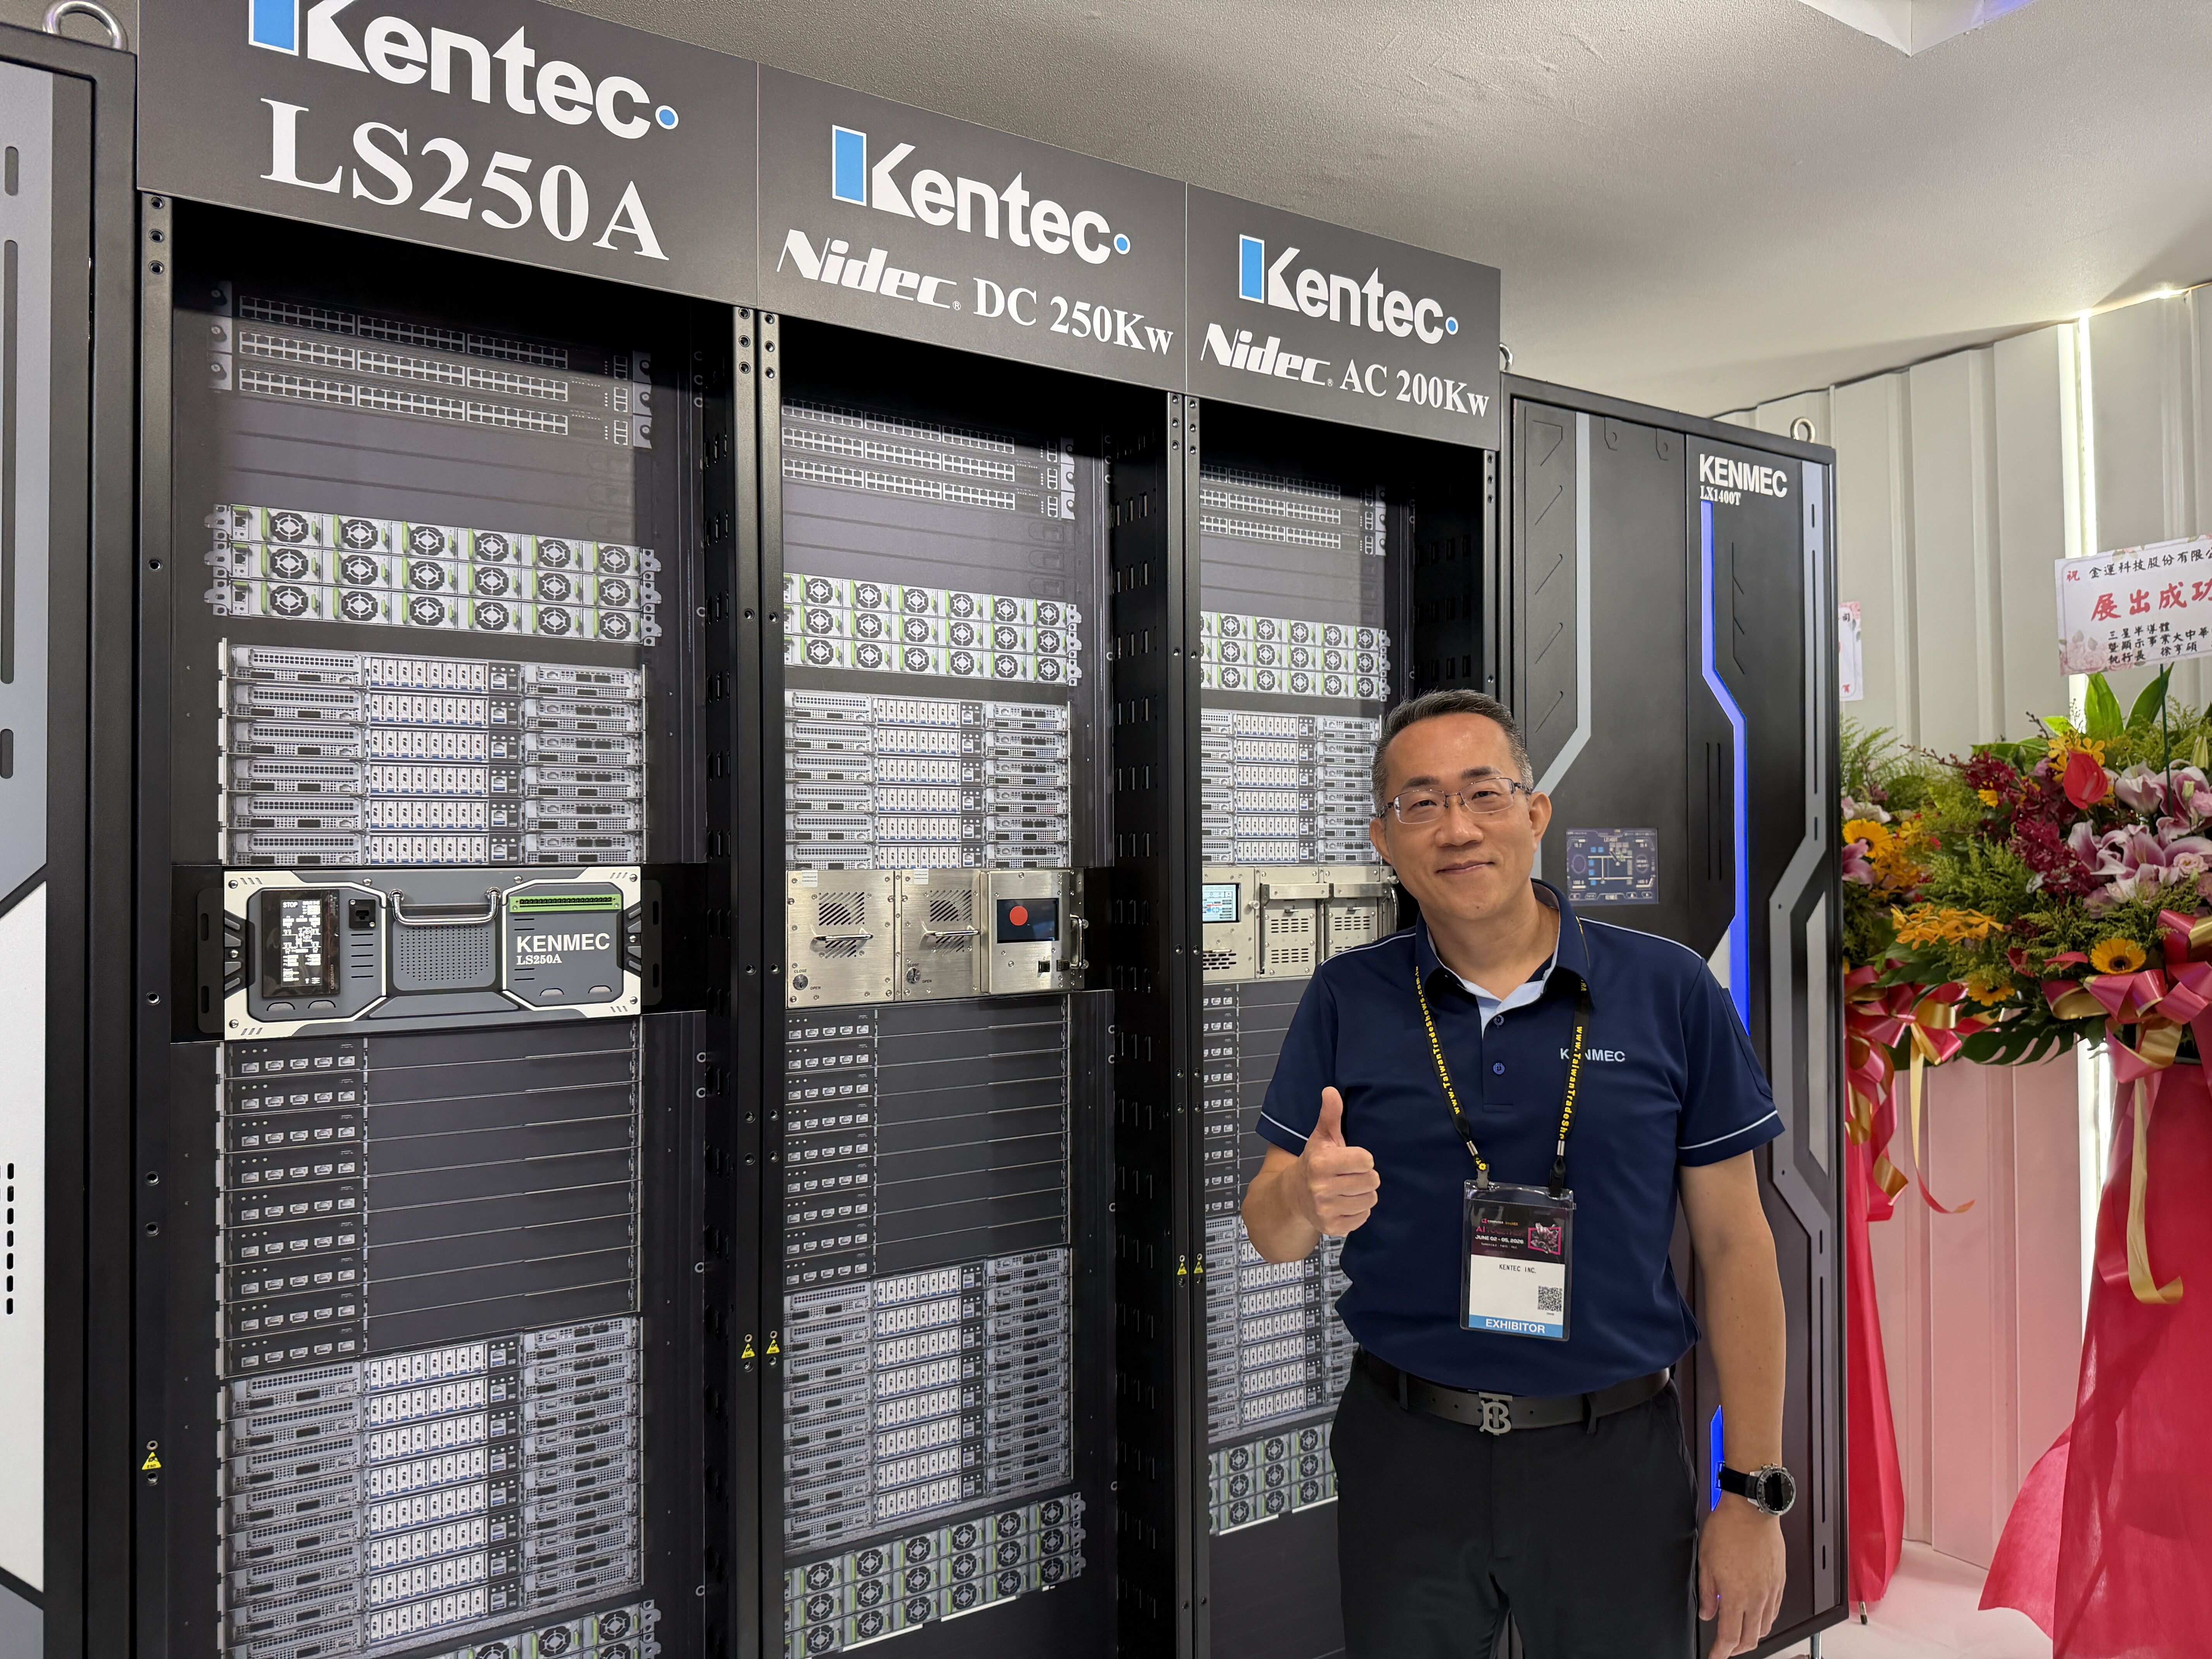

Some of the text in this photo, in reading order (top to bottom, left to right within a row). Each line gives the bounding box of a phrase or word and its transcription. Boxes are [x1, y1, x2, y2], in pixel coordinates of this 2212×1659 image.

[307, 0, 651, 139] Kentec
[260, 98, 670, 261] LS250A
[872, 142, 1111, 264] Kentec
[973, 277, 1037, 327] DC
[1050, 295, 1174, 355] 250Kw
[1267, 247, 1444, 345] Kentec
[1339, 359, 1388, 397] AC
[1396, 370, 1489, 417] 200Kw
[1700, 454, 1788, 498] KENMEC
[1700, 485, 1741, 506] LX1400T
[2066, 570, 2080, 582] 祝
[2091, 578, 2212, 622] 展出成功
[516, 954, 562, 965] LS250A
[517, 933, 610, 953] KENMEC
[1560, 1048, 1626, 1062] KNMEC
[1499, 1264, 1521, 1272] KENTEC
[1486, 1318, 1545, 1333] EXHIBITOR
